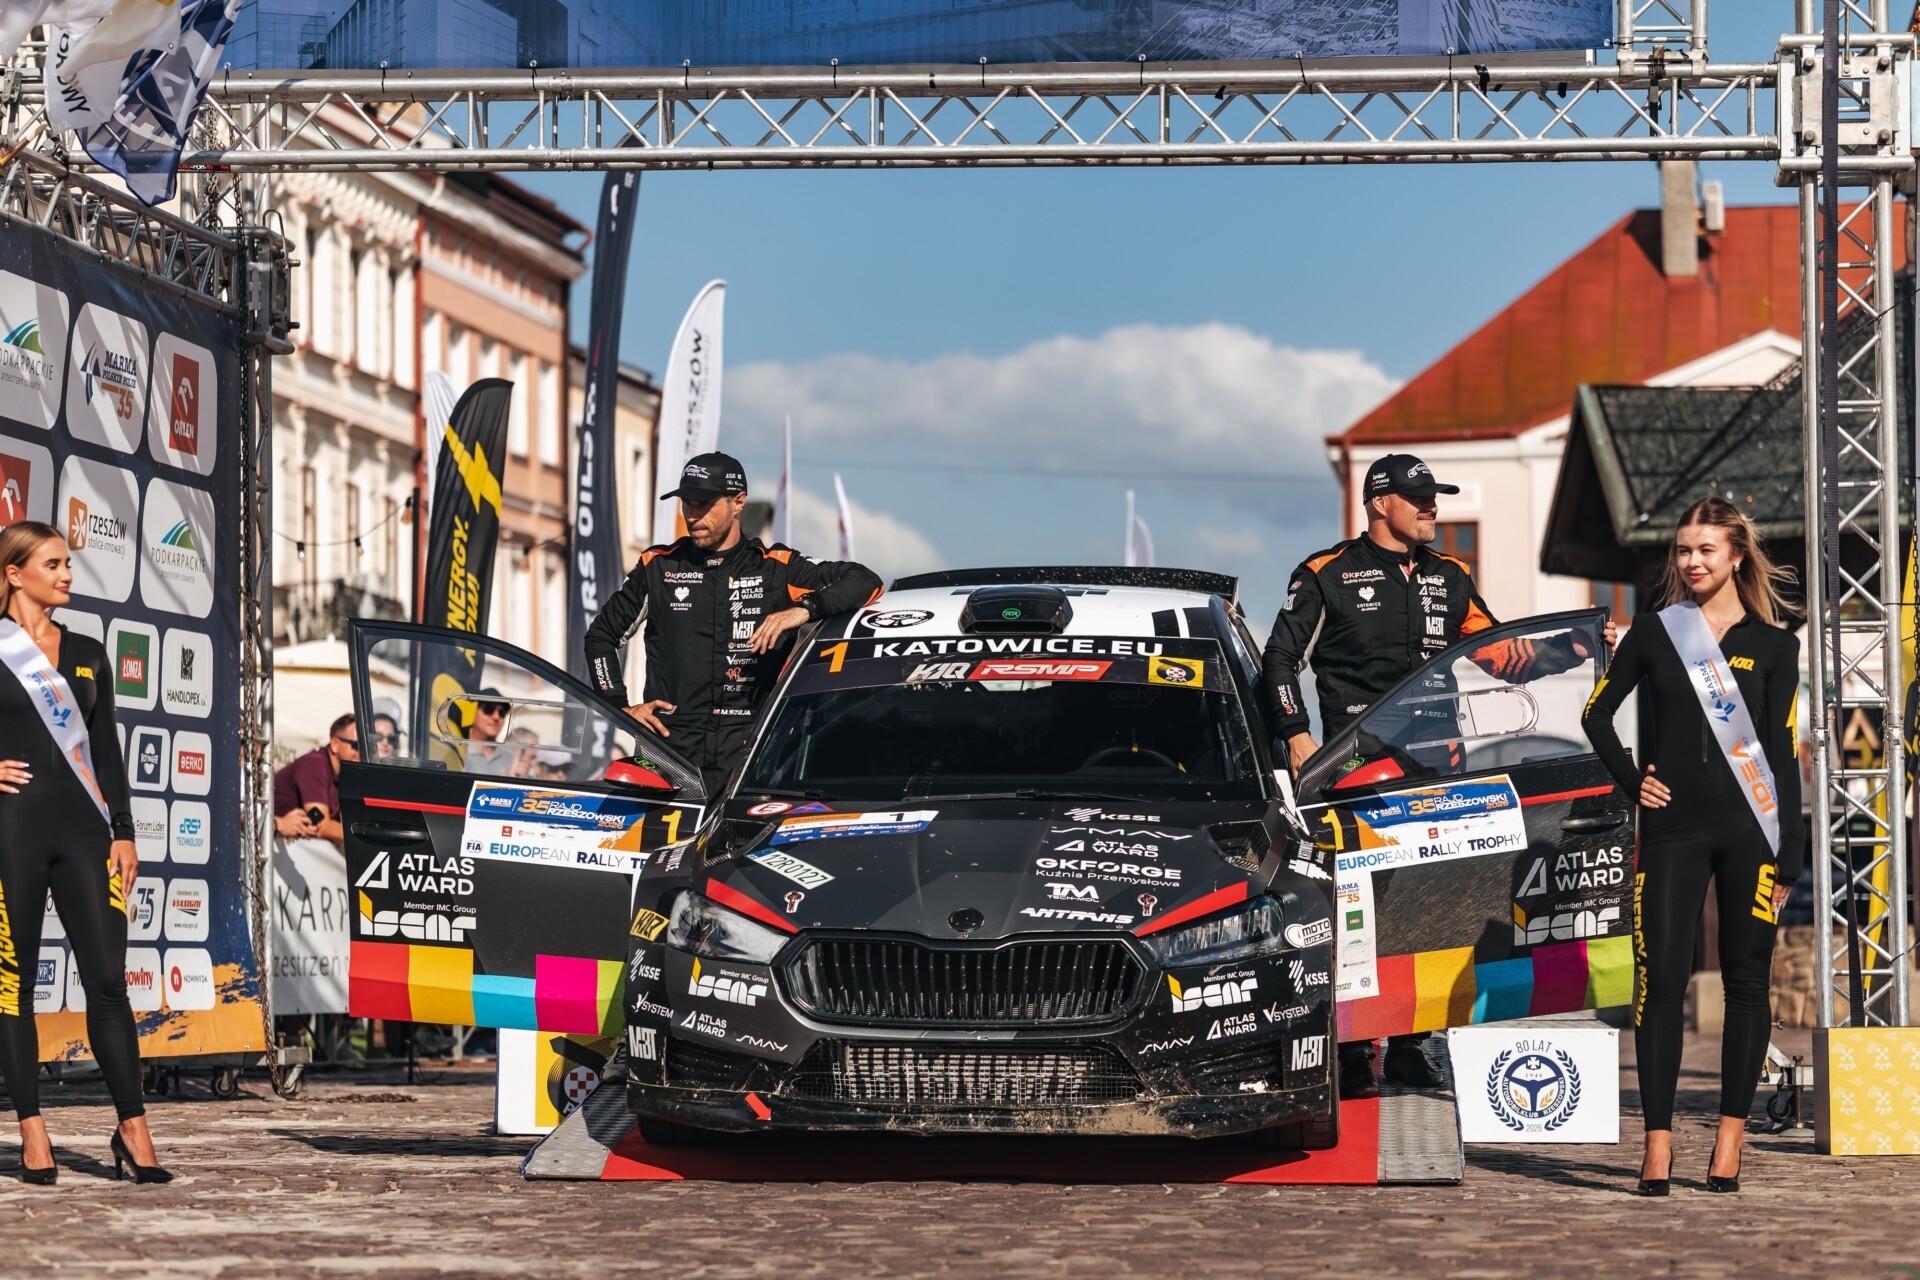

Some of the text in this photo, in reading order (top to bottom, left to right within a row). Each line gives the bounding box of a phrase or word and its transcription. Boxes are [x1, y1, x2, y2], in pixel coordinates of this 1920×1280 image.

[105, 351, 137, 376] MARMA
[117, 386, 134, 419] 35
[174, 419, 194, 439] ORLEN
[578, 430, 595, 537] OILS
[88, 514, 127, 540] rzeszów
[151, 547, 205, 573] PODKARPACKIE
[1341, 569, 1384, 579] GKFORGE
[1428, 585, 1447, 593] ATLAS
[1428, 590, 1447, 598] WARD
[741, 607, 761, 615] KSSE
[1431, 603, 1448, 612] KSSE
[819, 637, 1163, 673] 1 KATOWICE.EU
[980, 664, 1100, 676] RSMP
[166, 689, 200, 706] HANDLOPEX
[518, 798, 551, 814] 35
[549, 801, 582, 811] RAJD
[1407, 798, 1437, 816] 35
[1433, 794, 1464, 804] RAJD
[1435, 793, 1508, 812] RZESZOWSKI
[1485, 800, 1510, 810] 2026
[547, 809, 626, 823] RZESZOWSKI
[890, 812, 905, 822] 1
[1100, 813, 1161, 823] KSSE
[598, 820, 624, 830] 2026
[661, 810, 682, 845] 1
[1320, 808, 1345, 850] 1
[1092, 840, 1159, 852] ATLAS
[1092, 847, 1159, 858] WARD
[1337, 848, 1414, 871] EUROPEAN
[1418, 841, 1463, 858] RALLY
[1467, 833, 1522, 851] TROPHY
[490, 842, 570, 861] EUROPEAN
[577, 852, 625, 868] RALLY
[1554, 847, 1623, 871] ATLAS
[398, 854, 475, 876] ATLAS
[1035, 857, 1182, 880] GKFORGE
[398, 874, 475, 896] WARD
[1035, 869, 1180, 887] Kuźnia Przemysłowa
[1554, 867, 1624, 891] WARD
[1346, 893, 1360, 903] 35
[1554, 897, 1621, 911] Member IMC Group
[404, 902, 476, 914] Member IMC Group
[1302, 919, 1330, 937] MOTO
[1304, 931, 1331, 946] WIZJA
[638, 964, 661, 981] KSSE
[719, 968, 769, 984] Member IMC Group
[1203, 969, 1256, 983] Member IMC Group
[1304, 971, 1329, 986] KSSE
[698, 1012, 727, 1028] ATLAS
[1223, 1012, 1256, 1028] ATLAS
[696, 1022, 726, 1038] WARD
[1223, 1022, 1257, 1037] WARD
[1515, 1039, 1552, 1053] 80 LAT
[1502, 1077, 1565, 1119] AUTOMOBILKLUB RZESZOWSKI
[1526, 1123, 1543, 1133] 2026
